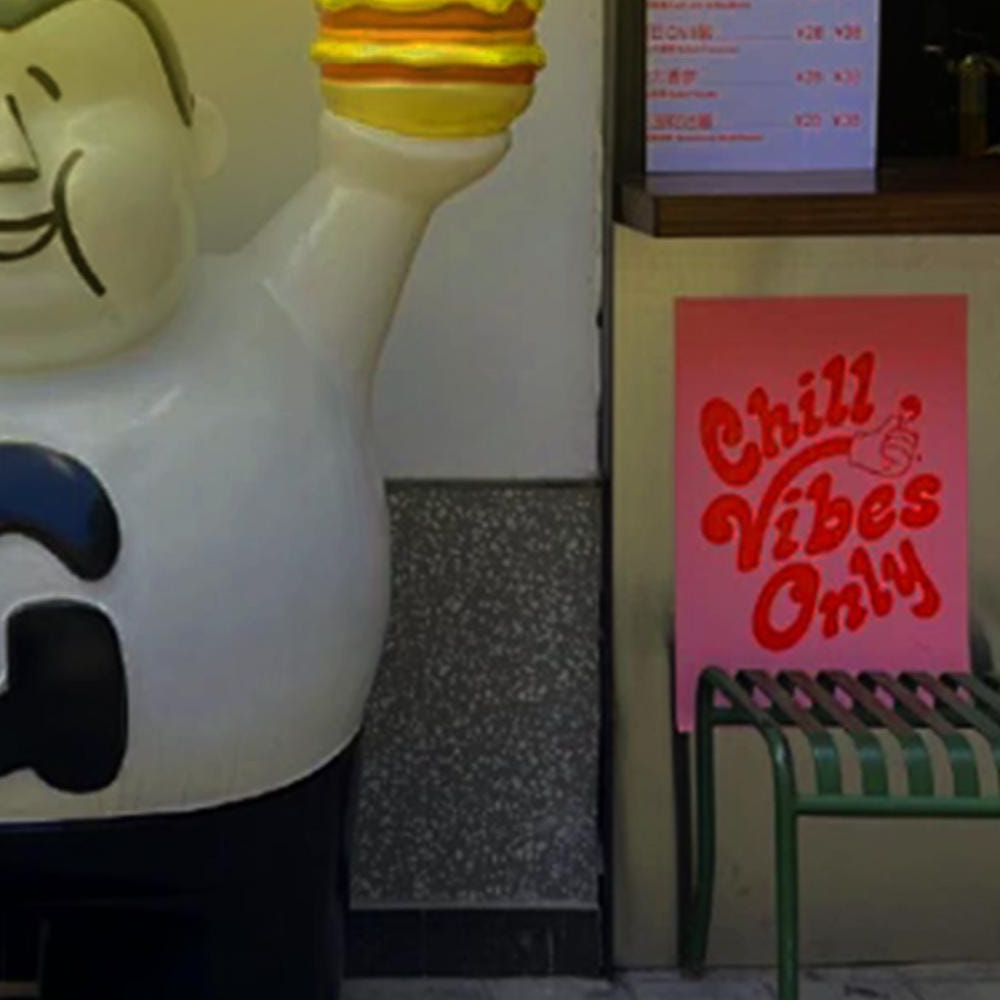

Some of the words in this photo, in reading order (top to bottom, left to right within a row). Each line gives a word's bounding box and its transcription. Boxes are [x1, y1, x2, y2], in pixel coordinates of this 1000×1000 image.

[699, 351, 876, 488] Chill
[700, 434, 943, 573] Vibes
[752, 538, 943, 652] Only
